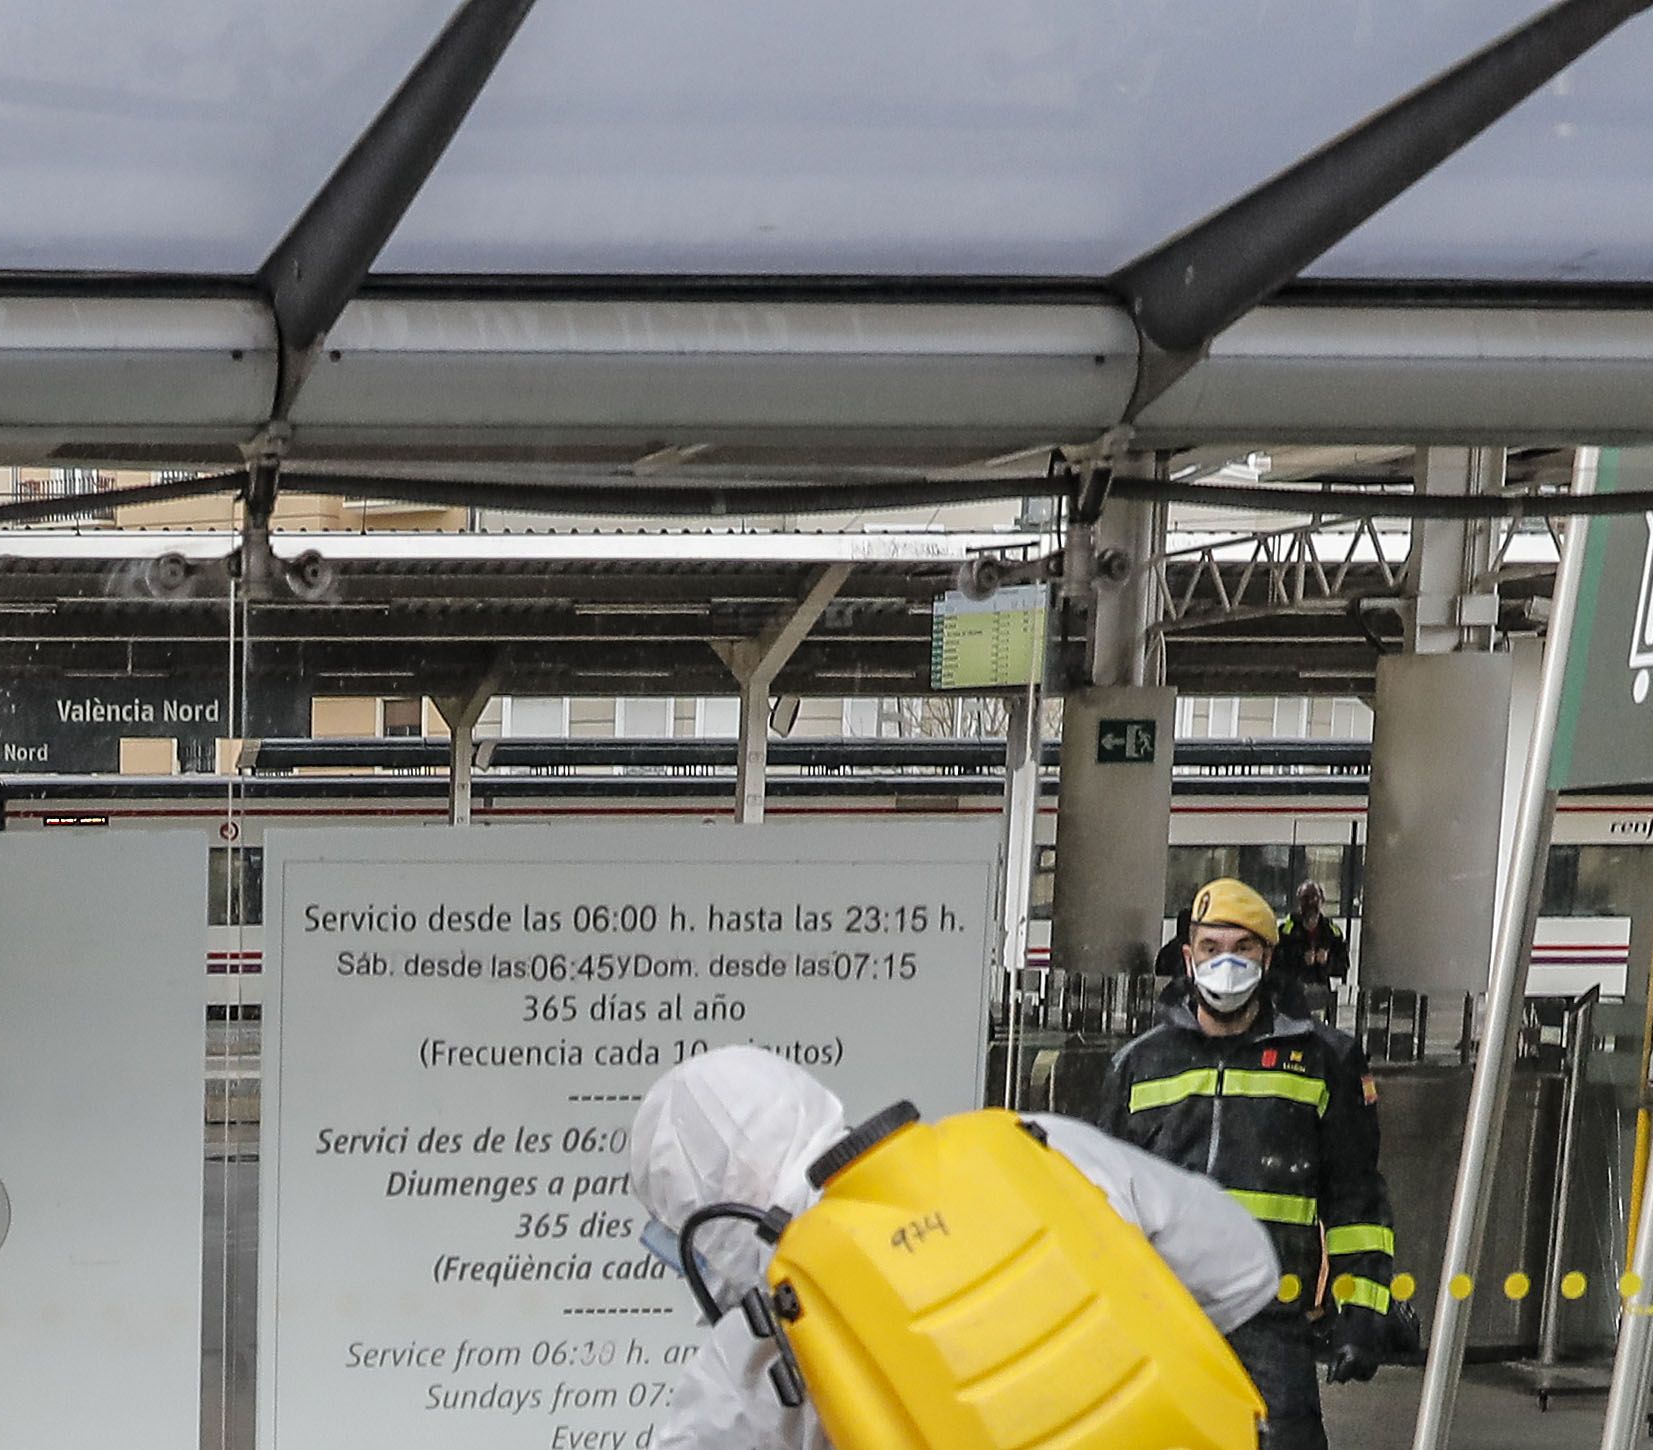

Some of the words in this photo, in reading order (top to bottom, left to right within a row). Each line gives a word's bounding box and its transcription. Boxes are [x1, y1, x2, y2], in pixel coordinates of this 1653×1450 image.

[57, 697, 154, 723] València
[163, 698, 219, 723] Nord
[4, 744, 48, 762] Nord
[304, 905, 417, 933] Servicio
[428, 905, 511, 933] desde
[523, 904, 562, 933] las
[573, 906, 657, 934] 06:00
[669, 905, 695, 933] h.
[708, 904, 783, 933] hasta
[796, 904, 833, 932] las
[846, 905, 928, 933] 23:15
[940, 904, 965, 932] h.
[337, 951, 394, 979] Sáb.
[404, 951, 482, 979] desde
[709, 954, 787, 978] desde
[523, 996, 578, 1023] 365
[590, 994, 651, 1023] días
[659, 995, 682, 1023] al
[694, 995, 746, 1022] año
[419, 1039, 583, 1069] (Frecuencia
[594, 1038, 660, 1067] cada
[316, 1127, 408, 1156] Servici
[514, 1127, 552, 1154] les
[562, 1127, 628, 1154] 06:0
[386, 1169, 540, 1202] Diumenges
[548, 1175, 565, 1196] a
[572, 1172, 631, 1203] part
[515, 1212, 569, 1240] 365
[580, 1211, 634, 1238] dies
[433, 1253, 592, 1284] (Freqüència
[602, 1253, 667, 1280] cada
[345, 1341, 448, 1369] Service
[452, 1339, 522, 1374] from
[626, 1338, 650, 1365] h.
[426, 1383, 542, 1414] Sundays
[548, 1381, 617, 1414] from
[628, 1382, 674, 1408] 07:
